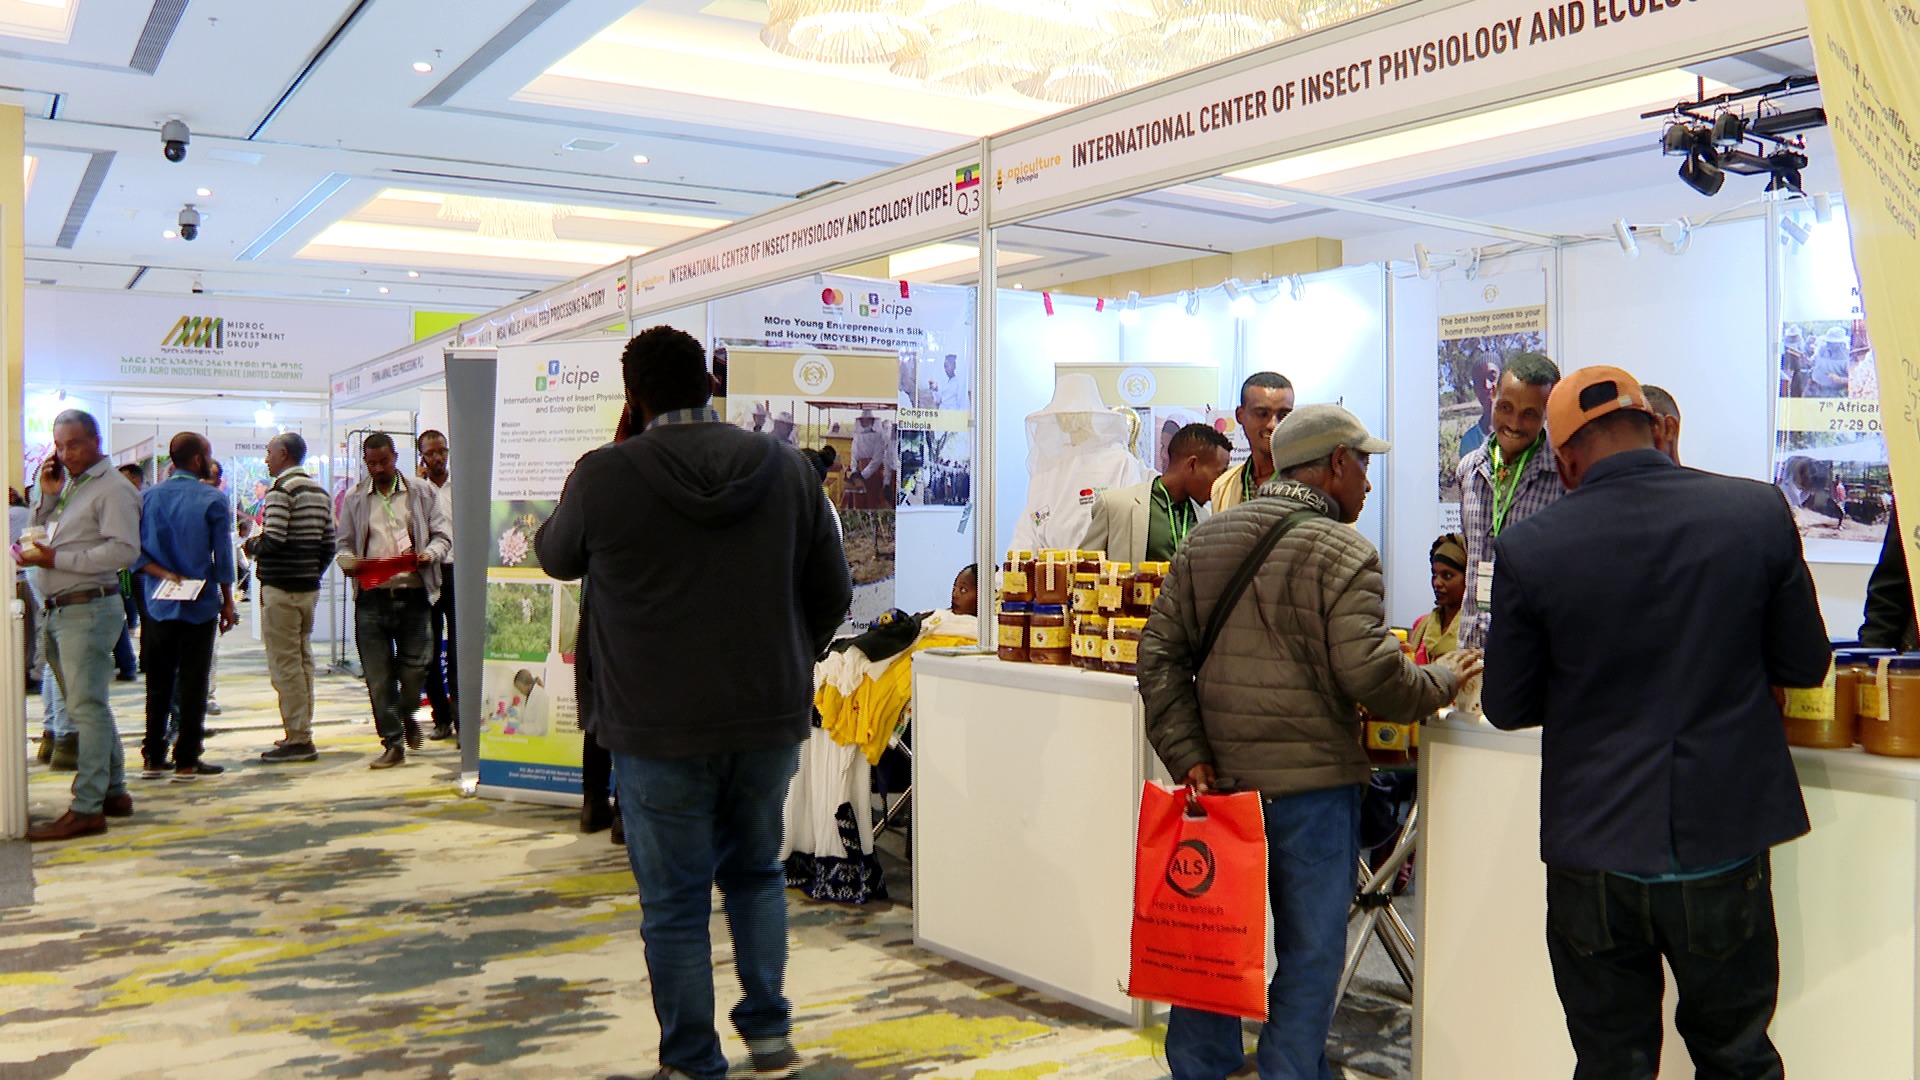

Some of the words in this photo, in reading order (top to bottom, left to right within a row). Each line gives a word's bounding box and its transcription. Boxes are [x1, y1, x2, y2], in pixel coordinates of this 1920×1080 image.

[1072, 114, 1195, 169] INTERNATIONAL
[1200, 90, 1268, 139] CENTER
[1273, 81, 1296, 114] OF
[1301, 59, 1373, 106] INSECT
[1380, 16, 1522, 85] PHYSIOLOGY
[1529, 0, 1585, 46] AND
[1007, 154, 1062, 180] apiculture
[957, 188, 980, 218] Q.3
[669, 252, 721, 285] INTERNATIONAL
[721, 247, 749, 272] CENTER
[750, 243, 760, 261] OF
[762, 232, 789, 258] INSECT
[791, 216, 844, 250] PHYSIOLOGY
[847, 210, 867, 234] AND
[869, 195, 914, 229] ECOLOGY
[916, 182, 953, 216] (ICIPE)
[881, 299, 913, 320] icipe
[1440, 318, 1453, 326] The
[1454, 316, 1469, 325] best
[1470, 315, 1490, 325] honey
[1492, 312, 1515, 321] comes
[1516, 311, 1523, 319] to
[1524, 309, 1541, 320] your
[227, 321, 265, 331] MIDROC
[764, 316, 792, 326] MOre
[794, 318, 824, 330] Young
[826, 320, 894, 336] Entrepreneurs
[896, 326, 904, 334] in
[906, 327, 924, 336] Silk
[1444, 328, 1463, 337] home
[1465, 326, 1490, 337] through
[1492, 323, 1513, 332] online
[1514, 320, 1538, 330] market
[227, 331, 286, 342] INVESTMENT
[765, 328, 784, 338] and
[786, 330, 818, 342] Honey
[227, 340, 261, 350] GROUP
[120, 365, 147, 374] ELFORA
[150, 366, 169, 375] AGRO
[172, 366, 212, 377] INDUSTRIES
[214, 368, 241, 378] PRIVATE
[243, 369, 269, 379] LIMITED
[271, 370, 304, 380] COMPANY
[562, 365, 600, 390] icipe
[504, 394, 542, 405] International
[544, 394, 564, 404] Centre
[566, 394, 574, 402] of
[575, 393, 596, 403] Insect
[550, 406, 575, 415] Ecology
[576, 404, 597, 414] (icipe)
[900, 407, 939, 419] Congress
[898, 420, 932, 431] Ethiopia
[1830, 418, 1864, 430] 27-29
[1172, 859, 1204, 876] ALS
[1154, 900, 1176, 911] Here
[1176, 902, 1188, 912] to
[1190, 903, 1224, 915] enrich
